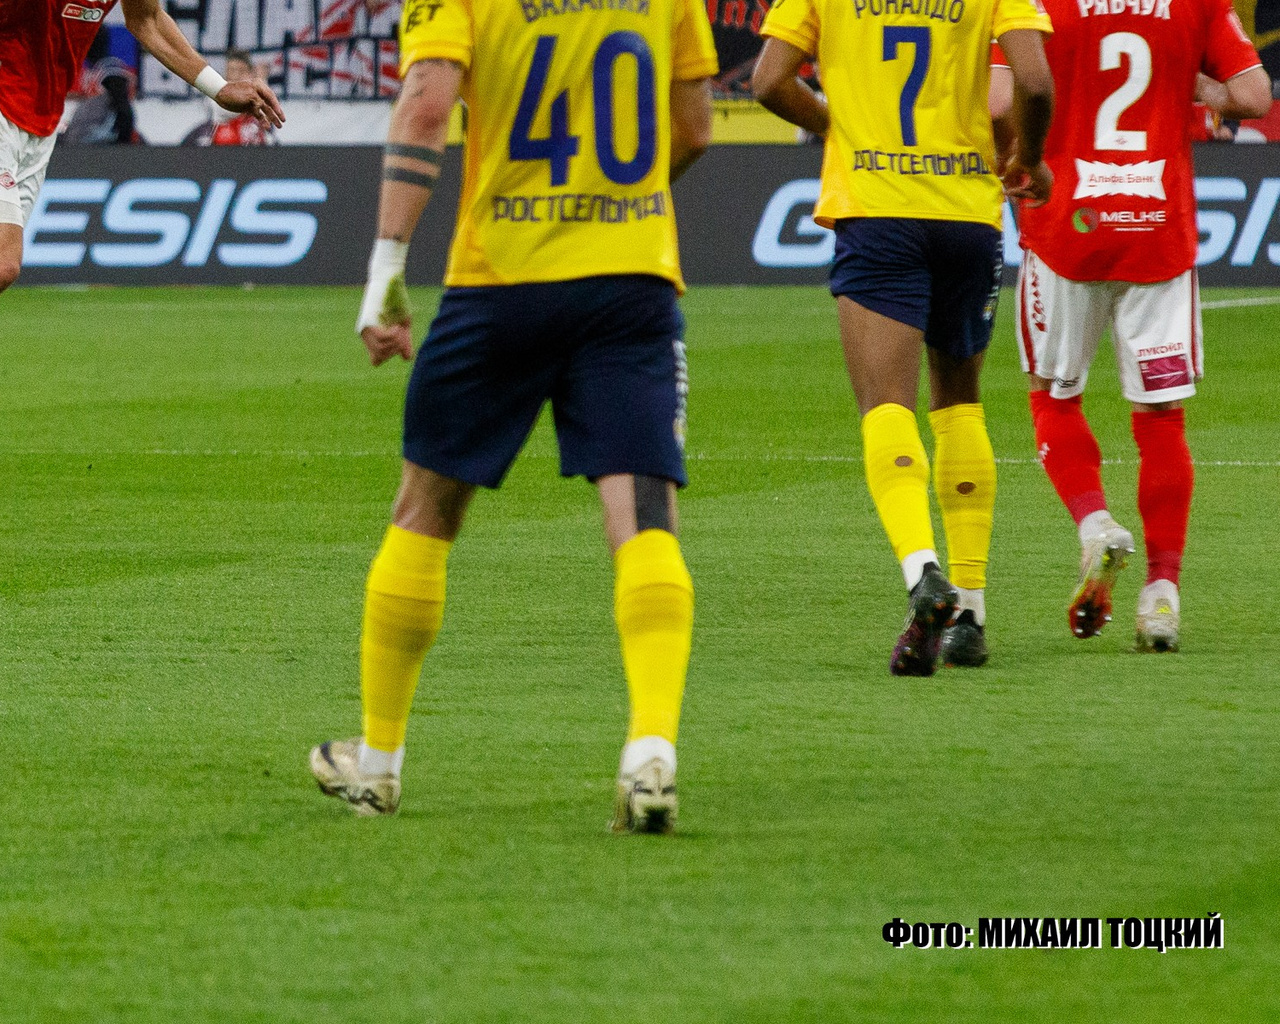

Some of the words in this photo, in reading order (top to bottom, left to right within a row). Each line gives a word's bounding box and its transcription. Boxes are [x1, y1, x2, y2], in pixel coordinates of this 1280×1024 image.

[509, 30, 657, 188] 40
[882, 26, 932, 147] 7
[1094, 32, 1152, 151] 2
[1100, 211, 1167, 223] MELKE
